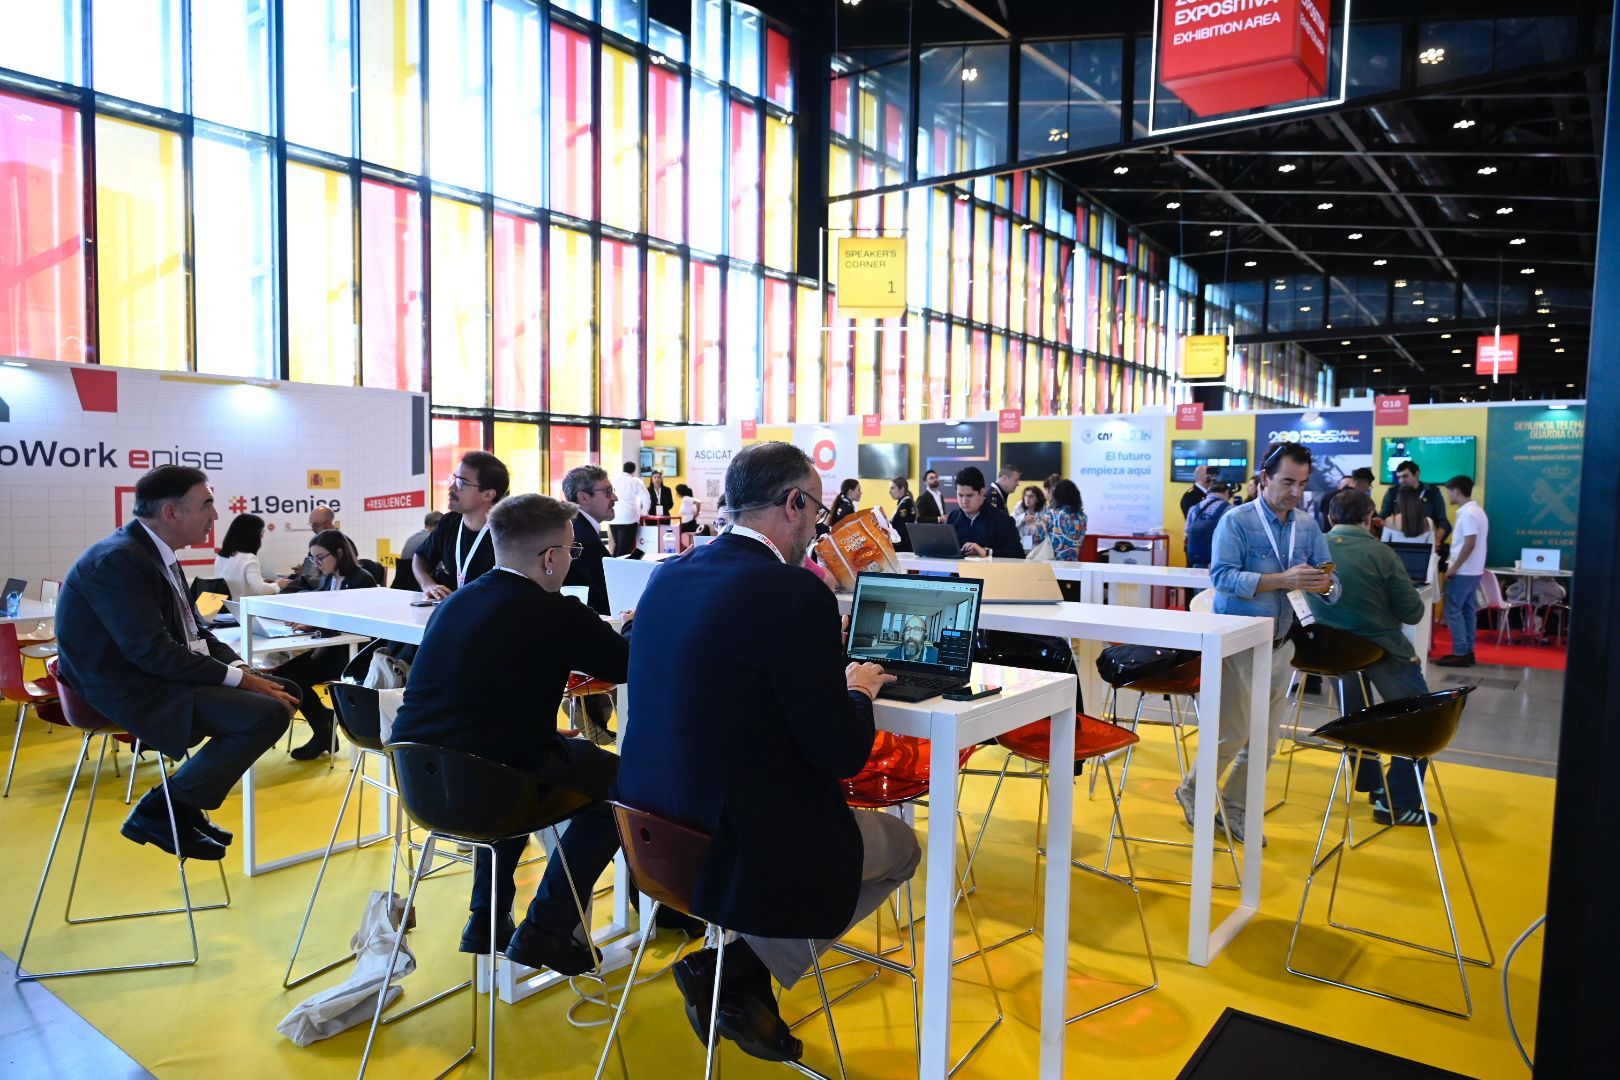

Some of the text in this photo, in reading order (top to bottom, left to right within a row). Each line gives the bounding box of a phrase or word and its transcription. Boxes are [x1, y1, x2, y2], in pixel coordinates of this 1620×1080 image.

[1173, 20, 1243, 45] EXHIBITION
[1243, 11, 1281, 30] AREA
[845, 249, 897, 258] SPEAKER'S
[845, 260, 886, 269] CORNER
[887, 280, 897, 294] 1
[1212, 358, 1220, 367] 2
[1382, 400, 1401, 408] 018
[0, 440, 223, 470] oWork enise
[694, 449, 732, 460] ASCICAT
[1106, 451, 1151, 461] El futuro
[1080, 465, 1125, 477] empieza
[366, 495, 412, 508] +RESILIENCE
